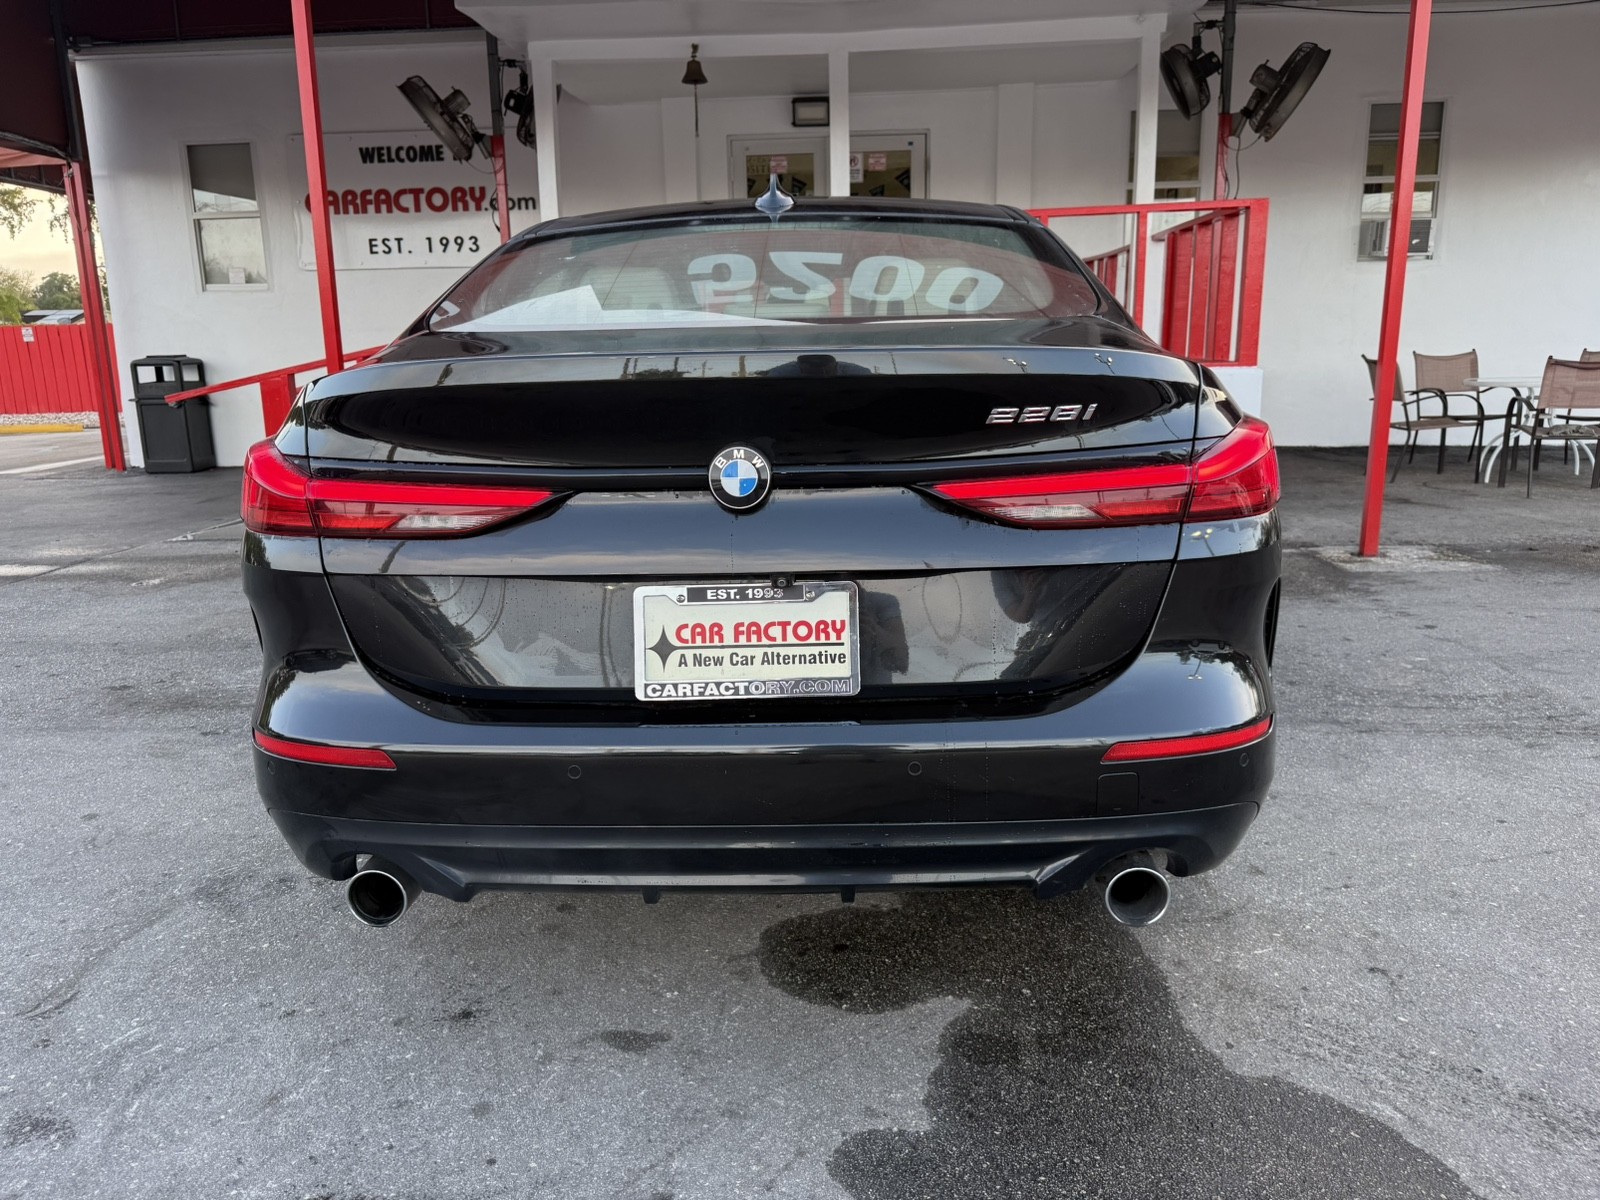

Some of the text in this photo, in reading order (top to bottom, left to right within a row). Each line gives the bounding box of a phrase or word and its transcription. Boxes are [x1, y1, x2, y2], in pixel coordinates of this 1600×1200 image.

[359, 145, 444, 164] WELCOME
[368, 236, 480, 255] EST. 1993
[714, 449, 765, 469] BMW
[706, 587, 784, 600] EST. 1993
[675, 619, 846, 644] CAR FACTORY
[678, 650, 847, 668] A New Car Alternative
[646, 679, 850, 698] CARFACTORY.COM
